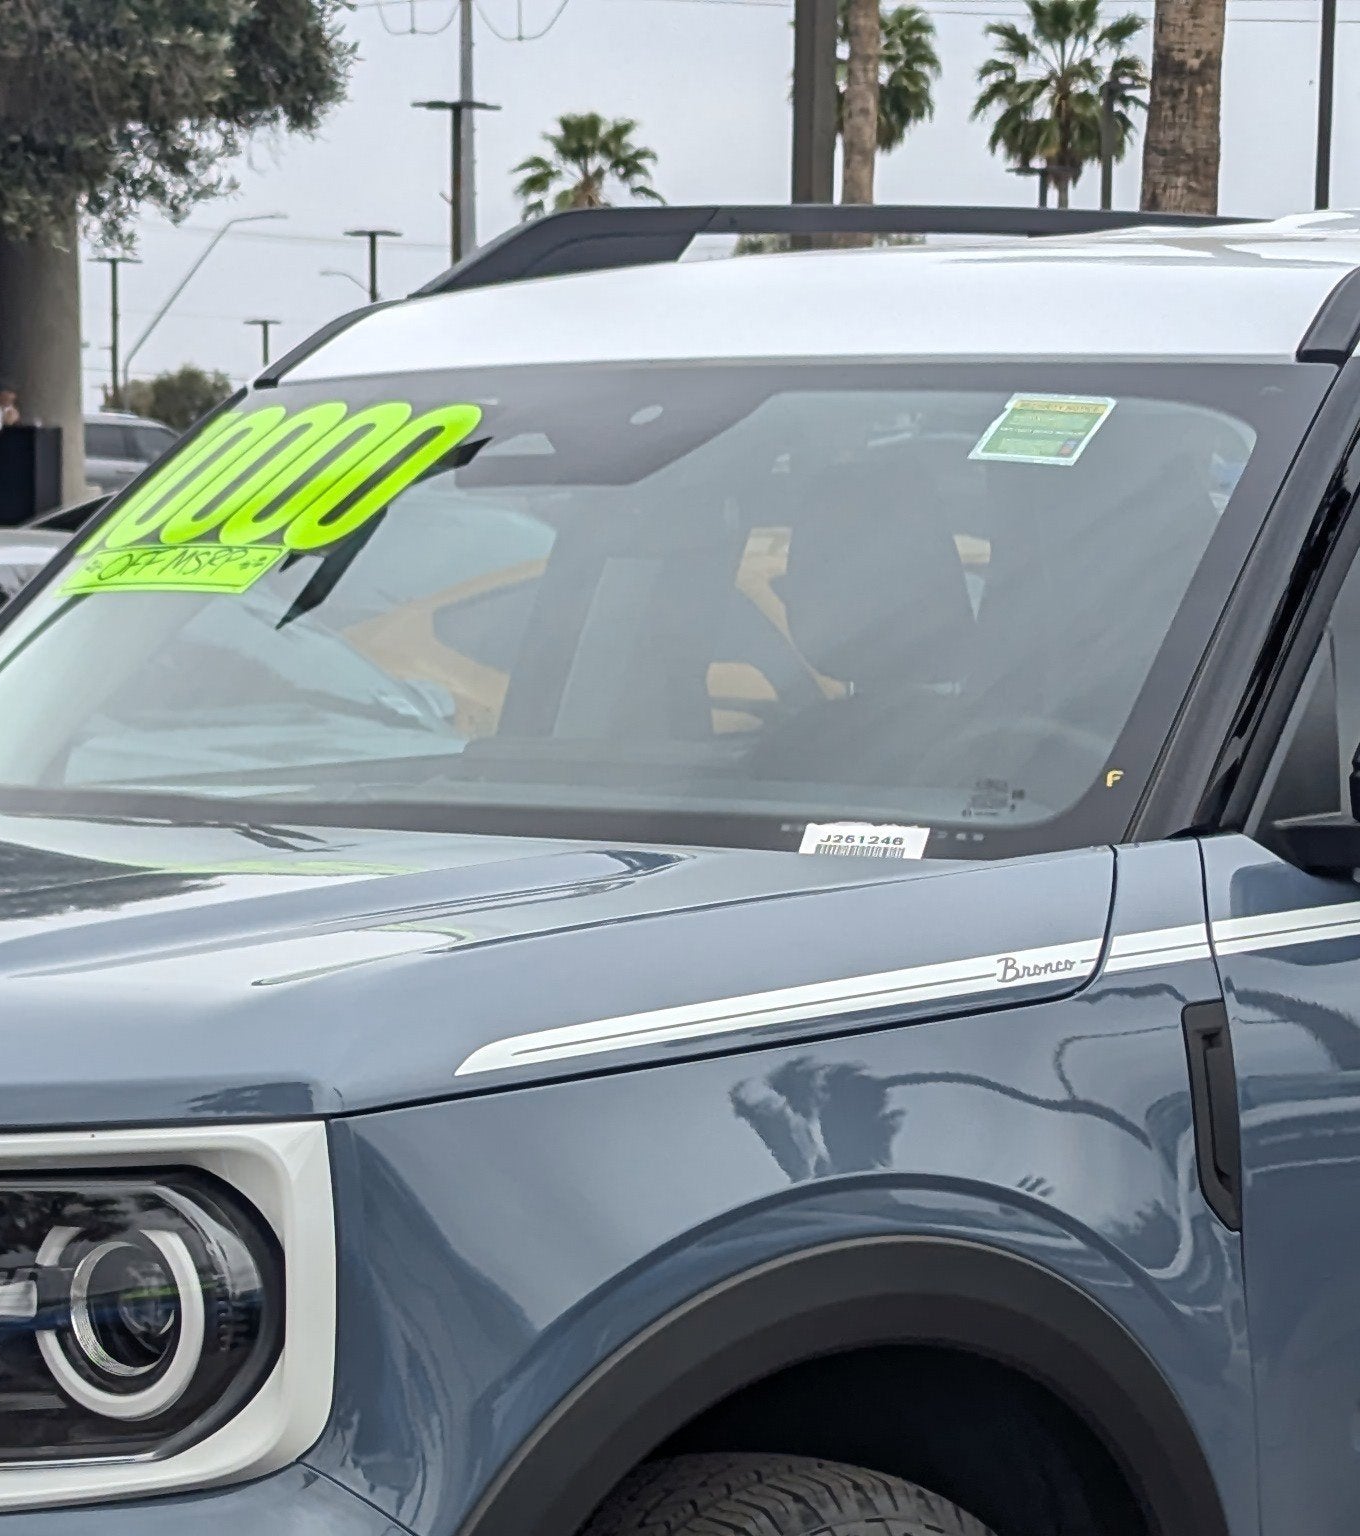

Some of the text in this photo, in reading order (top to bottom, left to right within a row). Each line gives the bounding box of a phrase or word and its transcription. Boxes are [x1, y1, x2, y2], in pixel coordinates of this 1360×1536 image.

[97, 549, 248, 581] OFF MSRP
[997, 957, 1076, 983] Bronco
